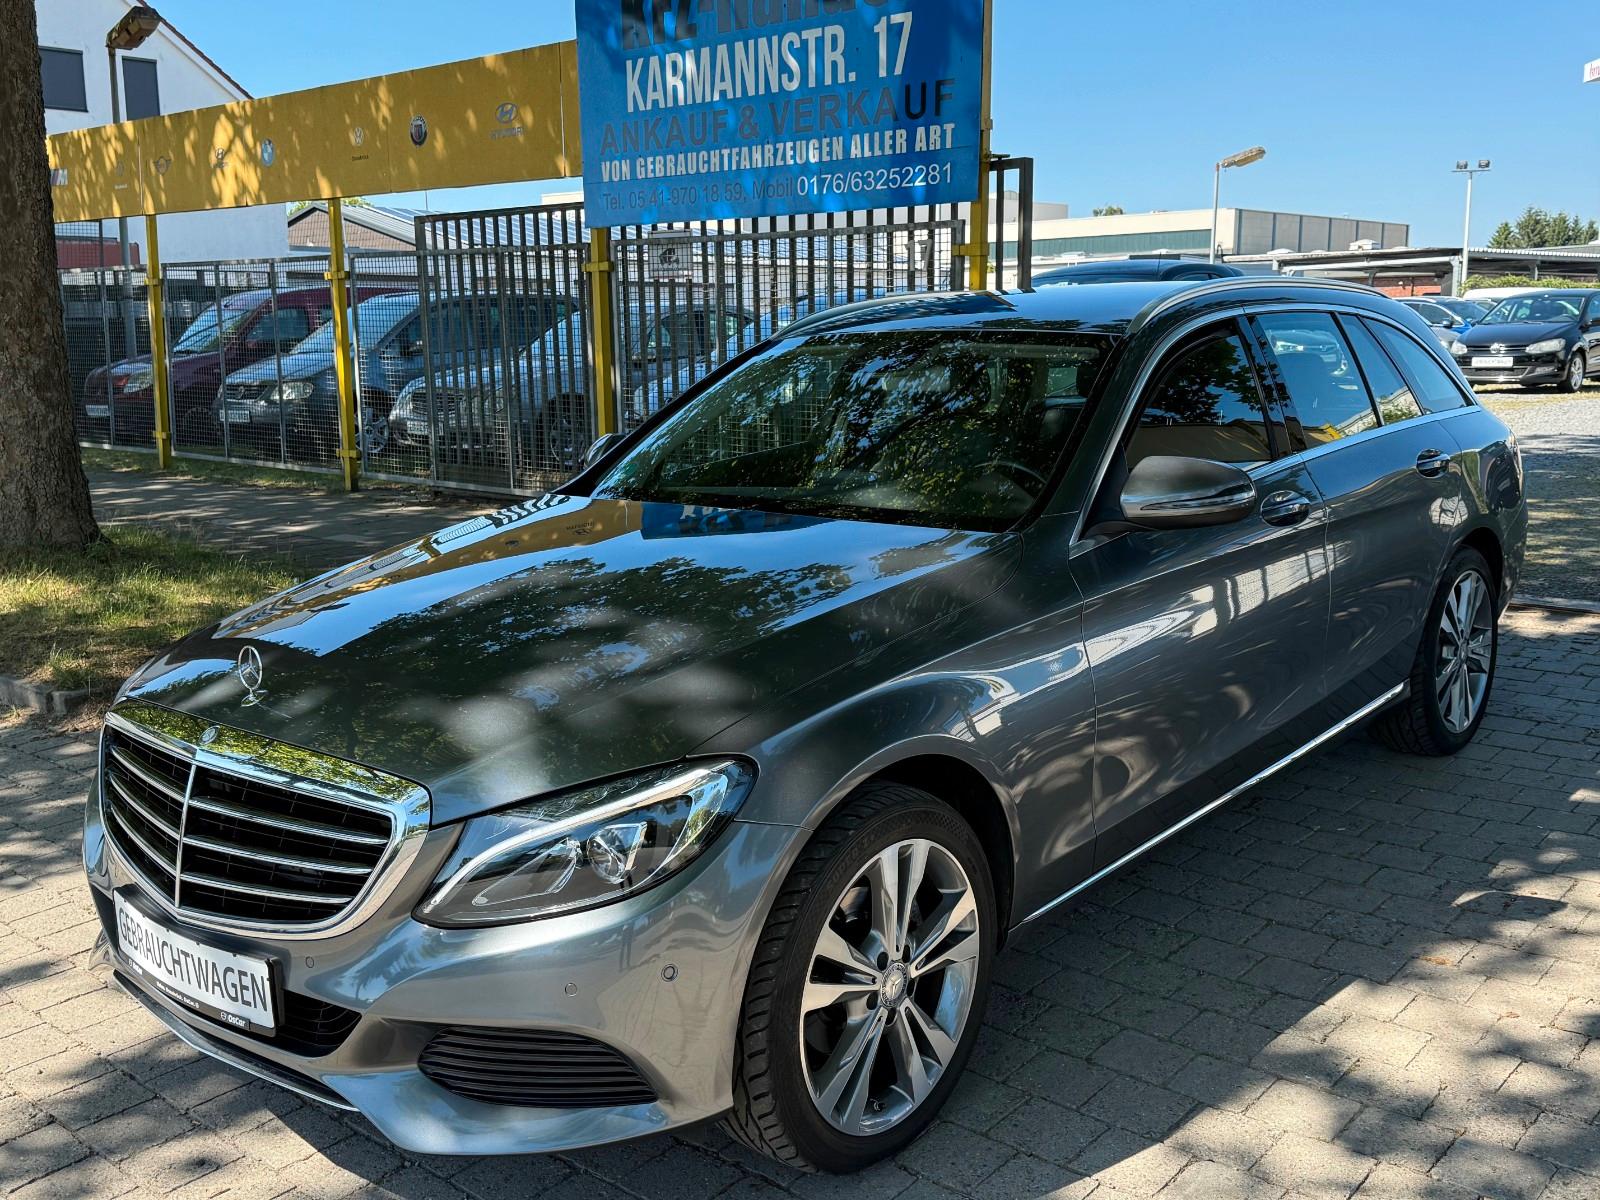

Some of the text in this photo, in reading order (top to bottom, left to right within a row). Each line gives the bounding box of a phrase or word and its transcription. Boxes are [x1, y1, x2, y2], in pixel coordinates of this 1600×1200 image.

[626, 11, 913, 113] KARMANNSTR. 17
[601, 78, 955, 156] ANKAUF & VERKAUF
[601, 123, 955, 182] VON GEBRAUCHTFAHRZEUGEN ALLER ART
[603, 193, 625, 210] Tel.
[752, 177, 792, 199] Mobil
[797, 162, 951, 196] 0176/63252281
[119, 907, 268, 1012] GEBRAUCHTWAGEN
